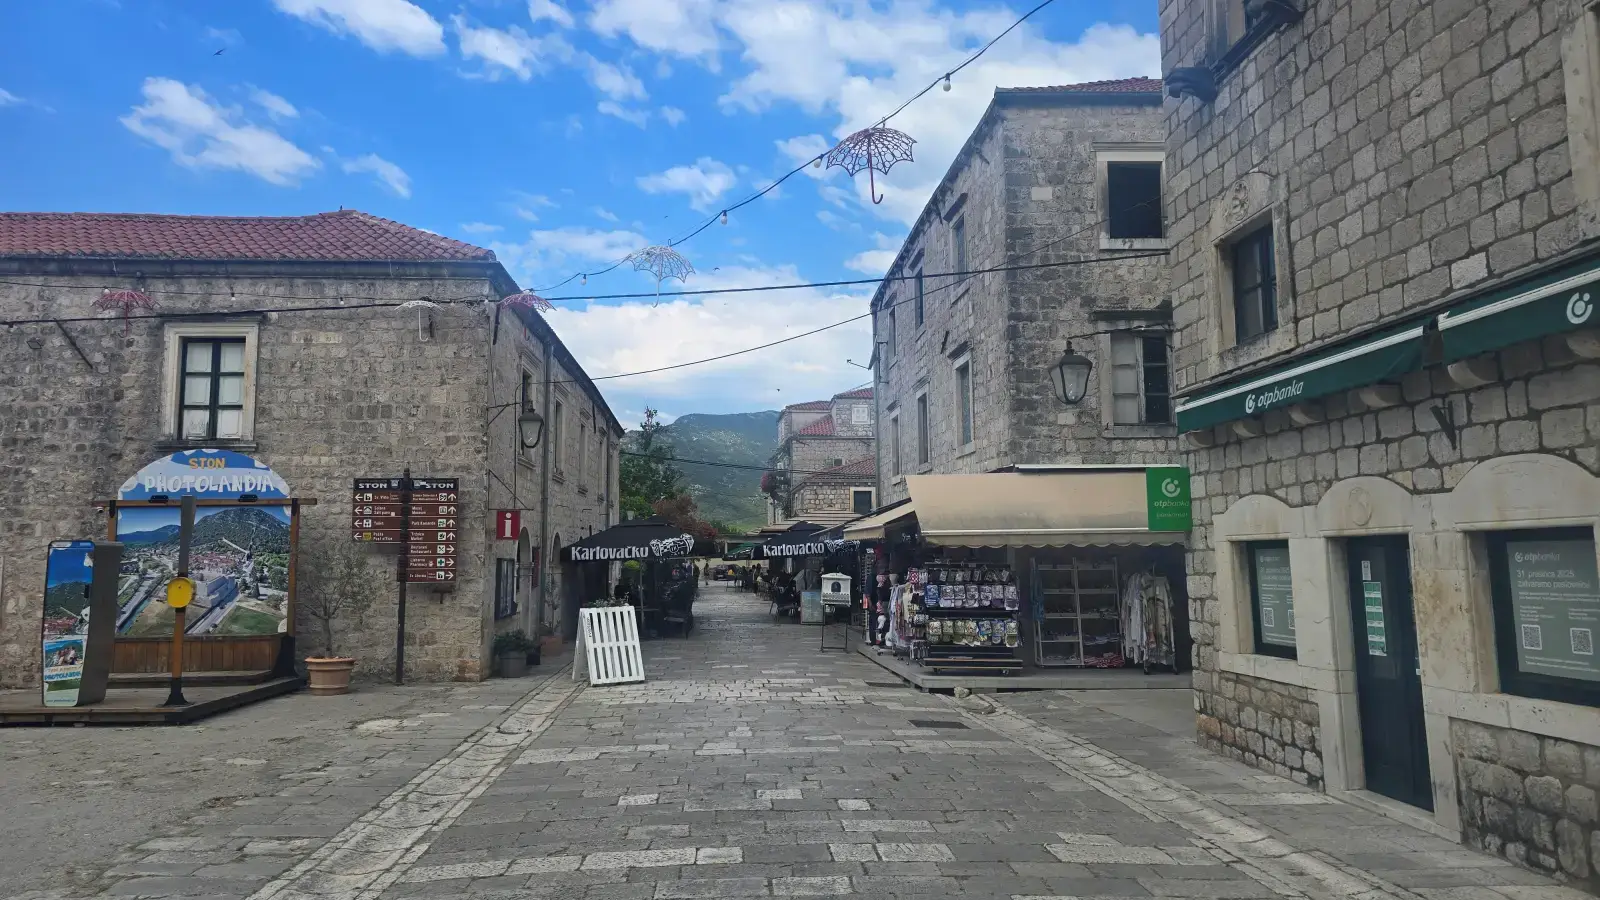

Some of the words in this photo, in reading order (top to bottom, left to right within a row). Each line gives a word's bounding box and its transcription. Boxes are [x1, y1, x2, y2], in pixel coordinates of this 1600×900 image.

[1257, 380, 1304, 408] otpbanka
[188, 457, 226, 470] STON
[144, 475, 275, 493] PHOTOLANDIA
[1154, 500, 1189, 509] otpbanka
[571, 545, 649, 561] Karlovačko
